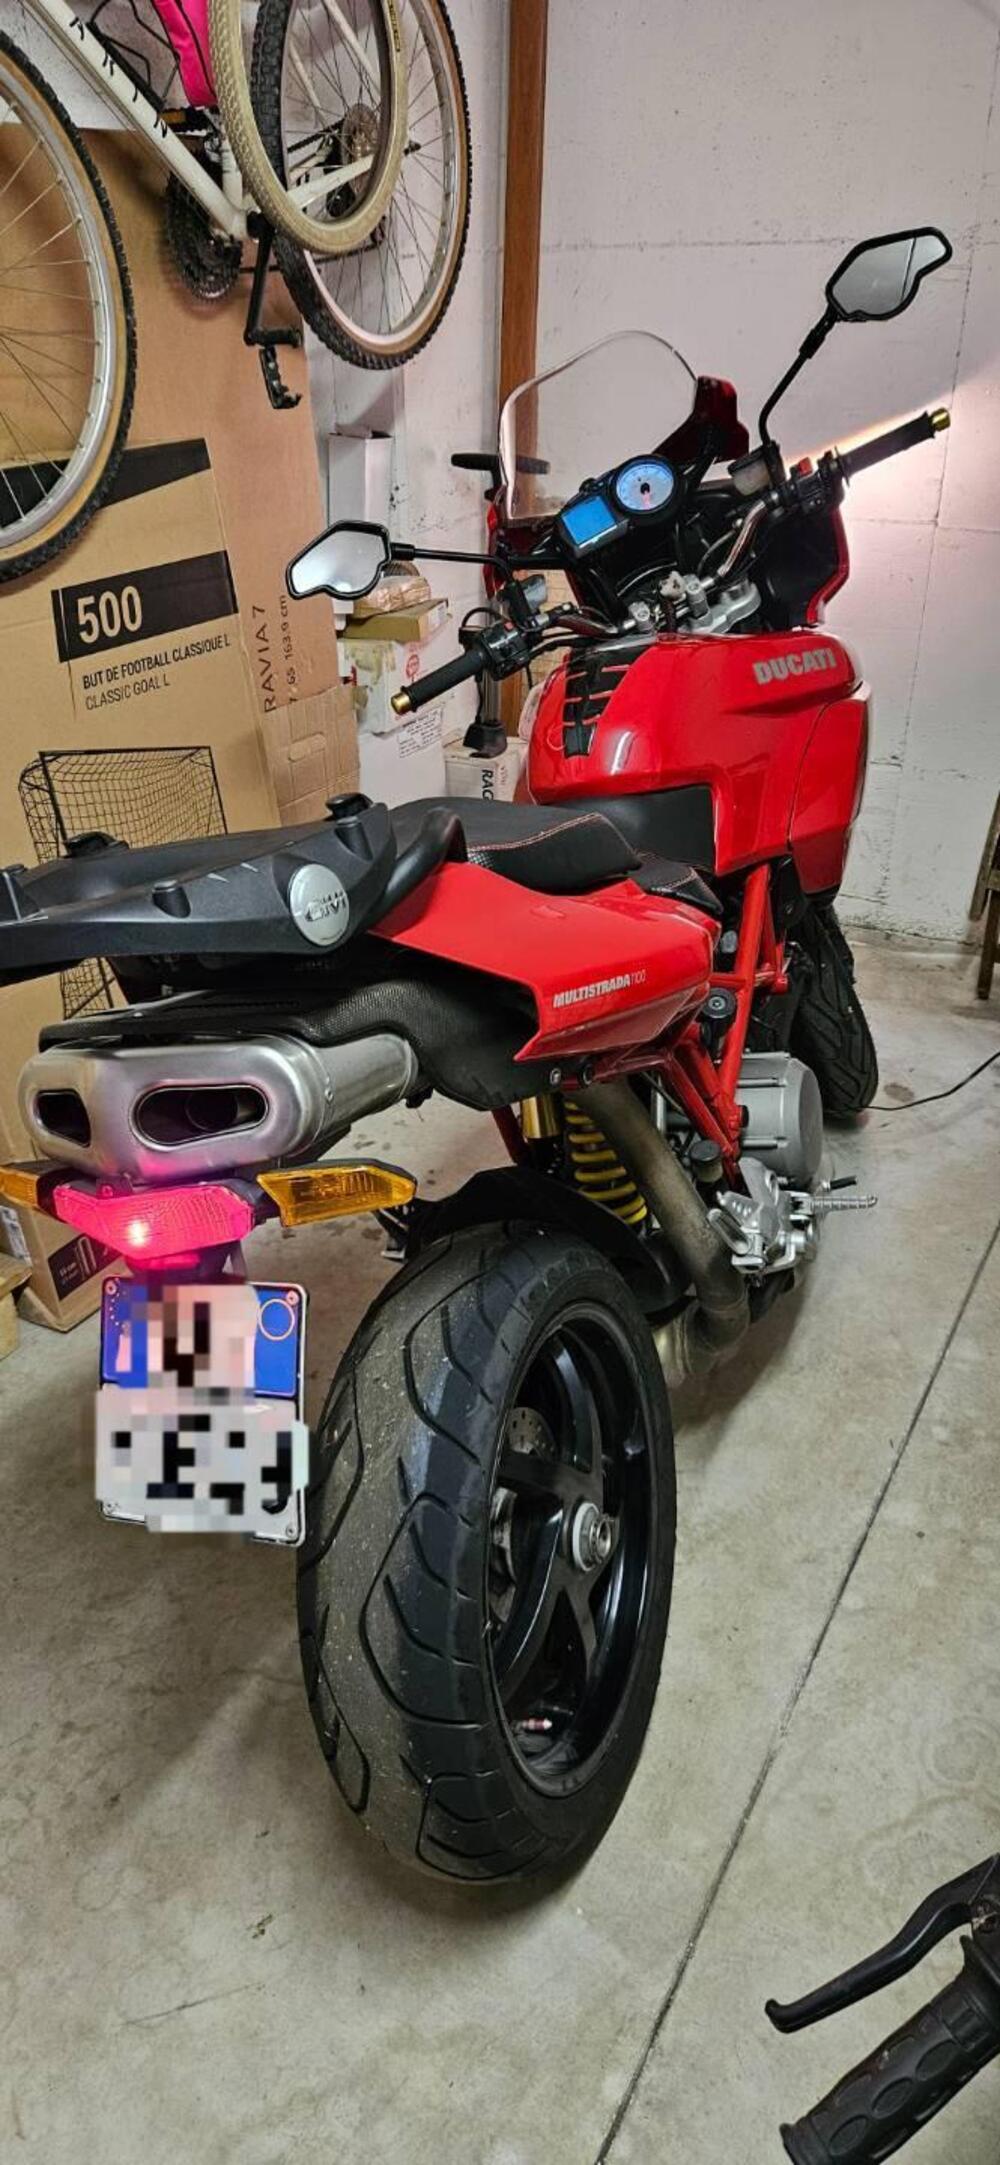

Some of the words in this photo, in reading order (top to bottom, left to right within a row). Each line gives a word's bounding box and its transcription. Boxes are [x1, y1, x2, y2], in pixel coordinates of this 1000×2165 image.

[77, 585, 143, 644] 500
[252, 605, 265, 619] 7
[280, 595, 288, 617] cm
[82, 671, 103, 690] BUT
[106, 665, 120, 683] DE
[121, 652, 172, 678] FOOTBALL
[172, 635, 223, 662] CLASSIQUE
[224, 634, 231, 647] L
[753, 648, 837, 685] DUCATI
[85, 684, 132, 711] CLASSIC
[133, 675, 161, 696] GOAL
[163, 674, 171, 686] L
[305, 890, 347, 922] GIVI
[553, 974, 630, 1009] MULTISTRADA
